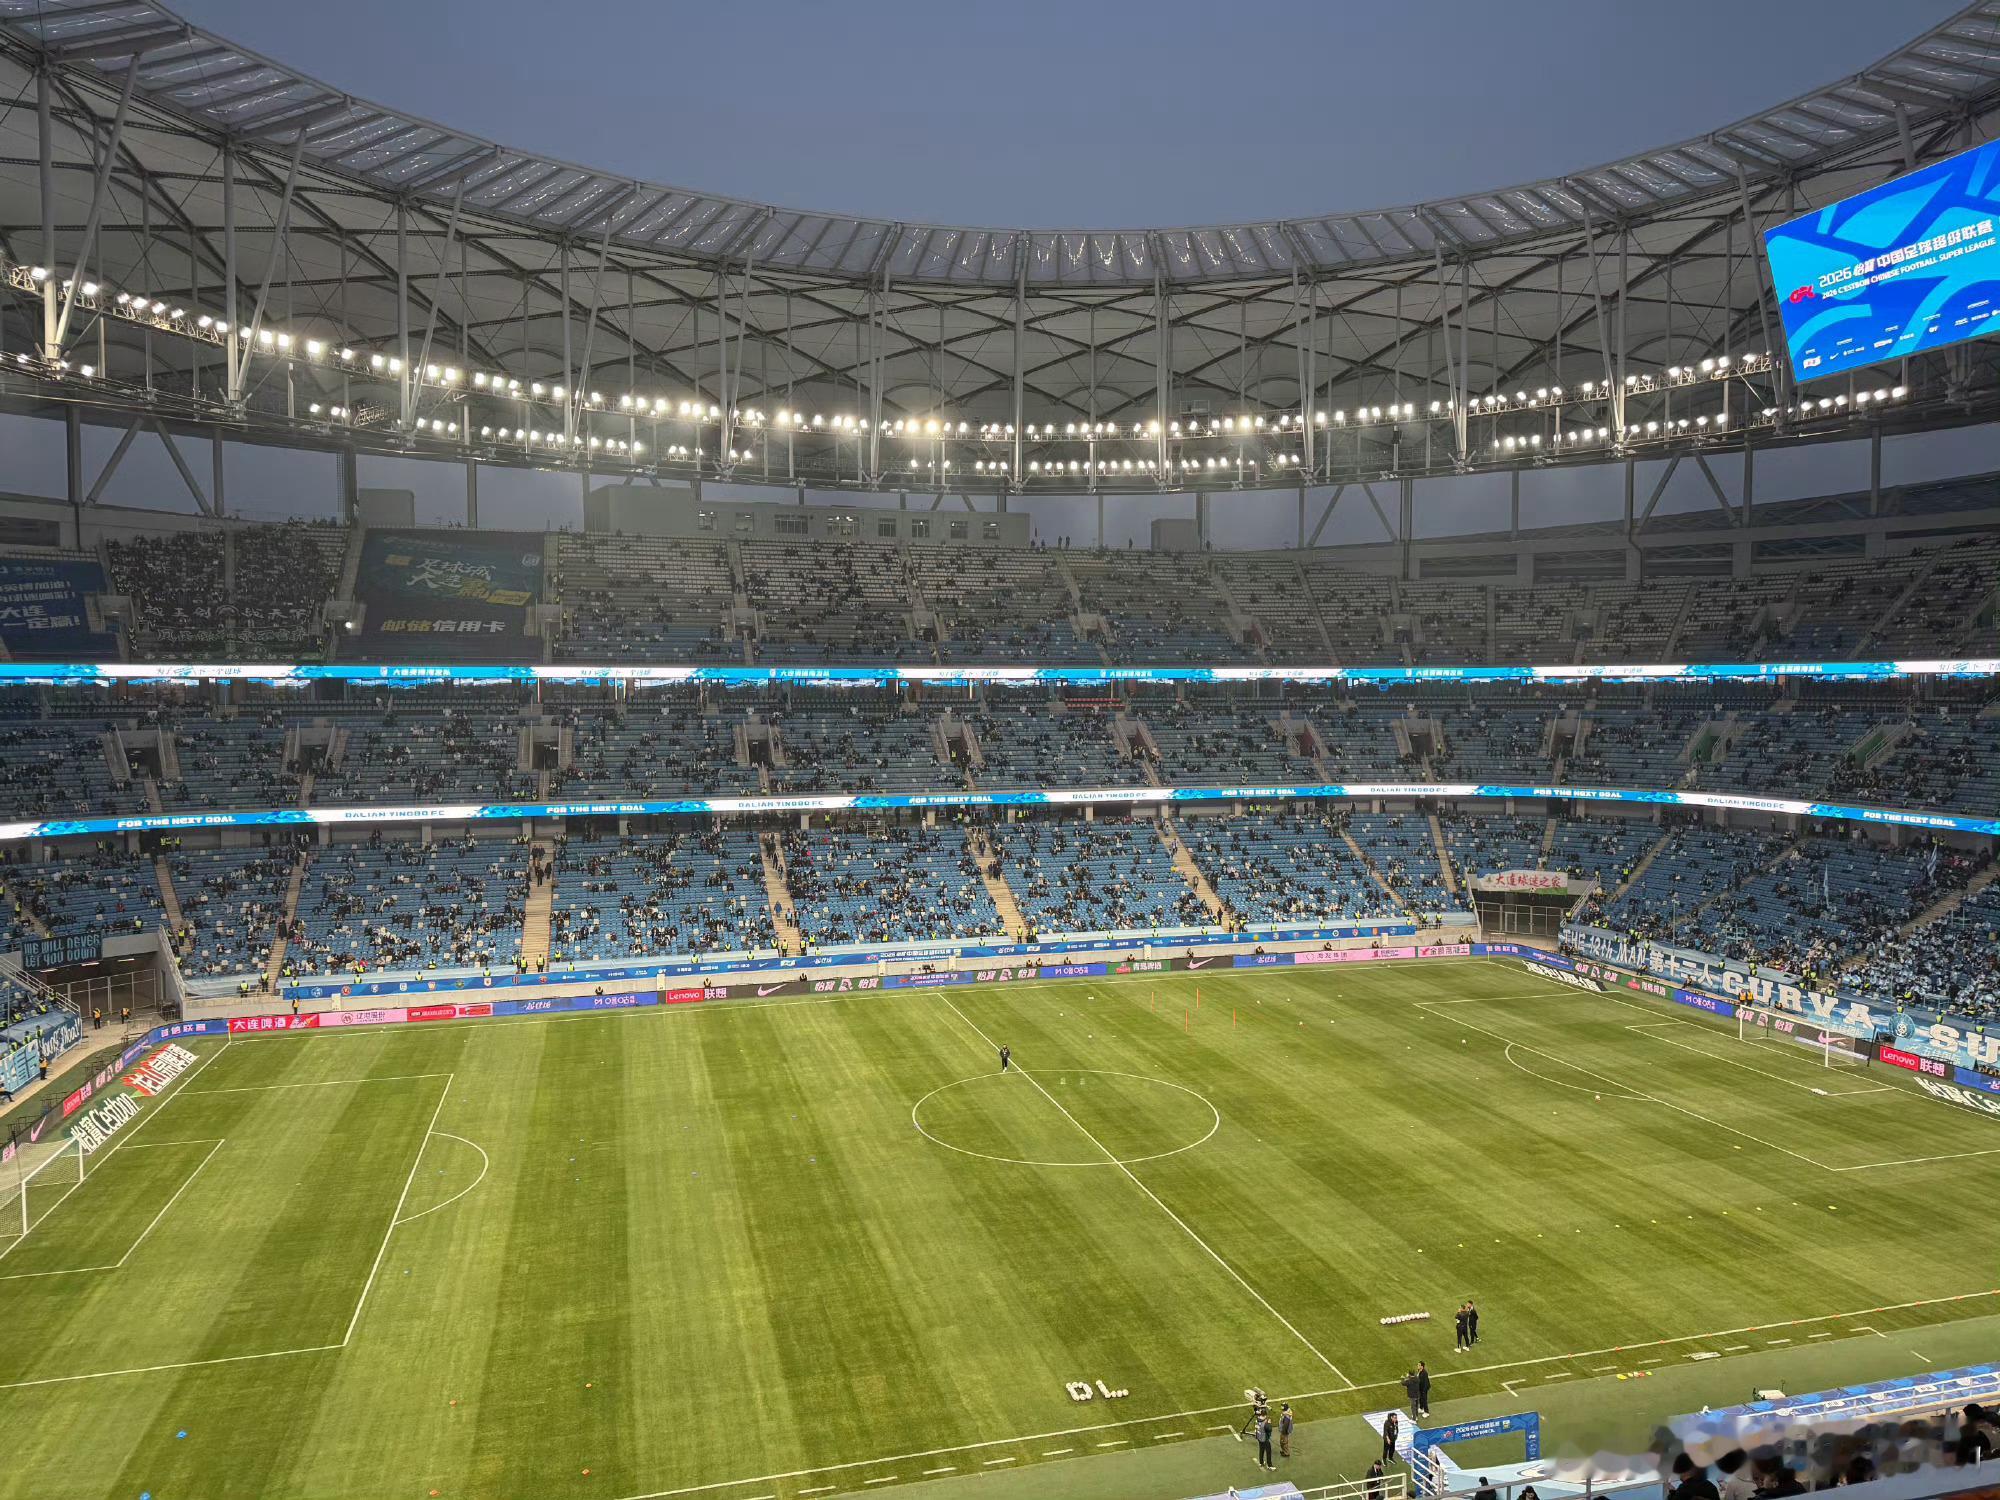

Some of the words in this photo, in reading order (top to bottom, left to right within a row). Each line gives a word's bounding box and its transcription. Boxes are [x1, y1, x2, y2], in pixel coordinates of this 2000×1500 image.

[1900, 259, 1938, 274] FOOTBALL
[1939, 249, 1964, 262] SUPER
[1965, 237, 1997, 253] LEAGUE
[1818, 267, 1852, 287] 2026
[1742, 800, 1772, 808] YINGBO
[145, 818, 169, 826] THE
[172, 817, 203, 825] NEXT
[1863, 811, 1881, 819] FOR
[1883, 813, 1902, 821] THE
[1903, 815, 1928, 824] NEXT
[1930, 818, 1956, 826] GOAL
[24, 943, 39, 955] WE
[41, 939, 65, 954] WILL
[67, 934, 100, 949] NEVER
[25, 955, 40, 968] LET
[43, 951, 64, 966] YOU
[67, 947, 97, 961] DOWN
[1562, 929, 1586, 951] THE
[1588, 936, 1613, 960] 12th
[1616, 942, 1647, 965] MAN
[1649, 950, 1714, 987] 第十二人
[669, 991, 700, 1000] Lenovo
[704, 987, 727, 1000] 联想
[233, 1018, 286, 1030] 大连啤酒
[1722, 970, 1875, 1031] CURVA
[1929, 1023, 2000, 1064] SU
[1883, 1050, 1915, 1066] Lenovo
[1920, 1057, 1945, 1077] 联想
[89, 1093, 140, 1136] C'estbon
[1065, 1379, 1129, 1401] DL
